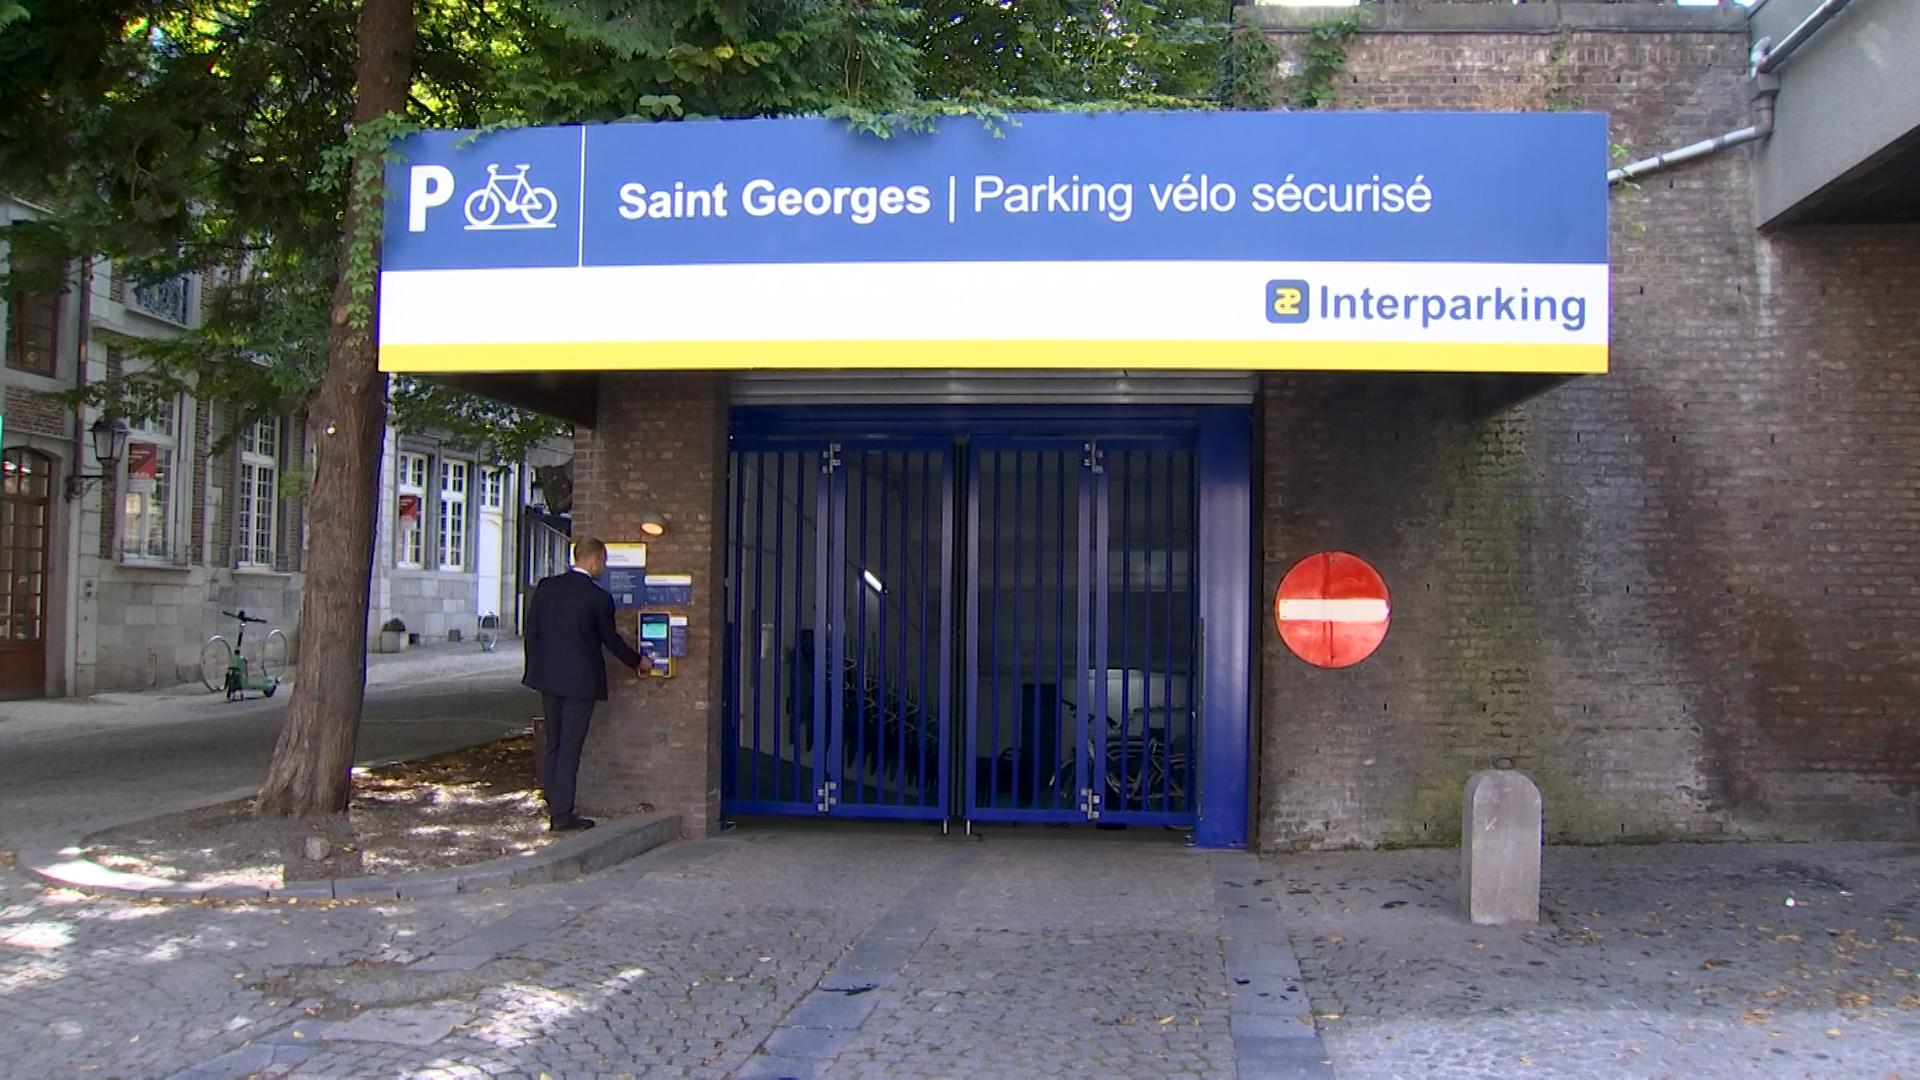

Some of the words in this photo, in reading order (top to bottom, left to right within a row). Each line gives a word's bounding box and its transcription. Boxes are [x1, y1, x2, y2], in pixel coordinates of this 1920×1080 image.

[408, 164, 455, 232] P
[618, 181, 728, 220] Saint
[741, 178, 931, 225] Georges
[974, 175, 1133, 222] Parking
[1148, 173, 1237, 212] vélo
[1251, 173, 1432, 213] sécurisé
[1320, 285, 1586, 332] Interparking
